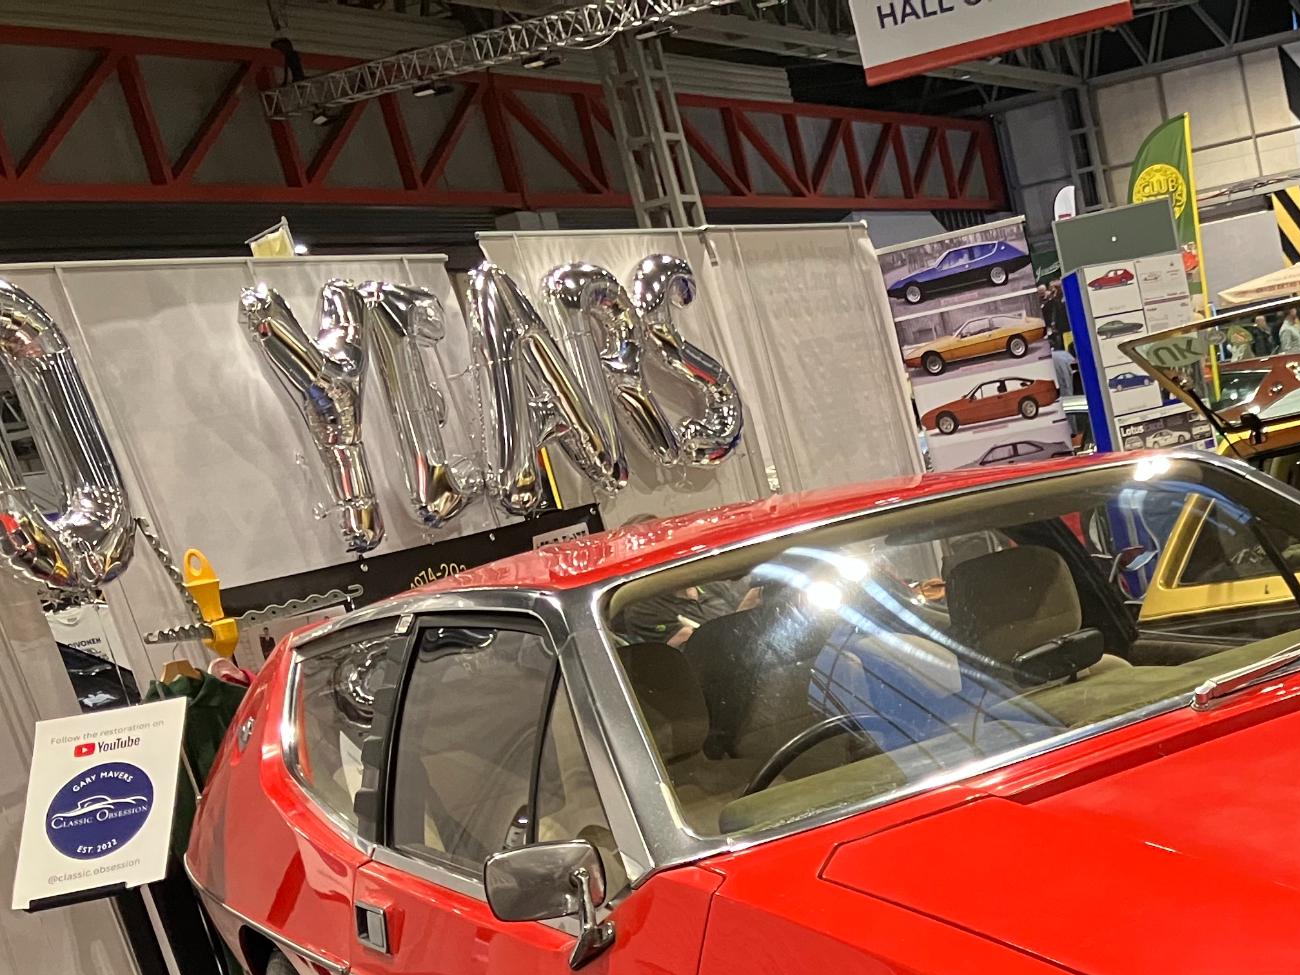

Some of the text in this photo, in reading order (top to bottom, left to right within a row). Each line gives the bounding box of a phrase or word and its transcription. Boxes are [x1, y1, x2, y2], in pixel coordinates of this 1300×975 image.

[1141, 177, 1178, 195] CLUB
[239, 253, 743, 554] YEARS
[51, 719, 164, 745] Follow the restoration on
[98, 736, 141, 753] YouTube
[72, 771, 134, 792] GARY MAVERS
[48, 858, 141, 885] @classic.obsession
